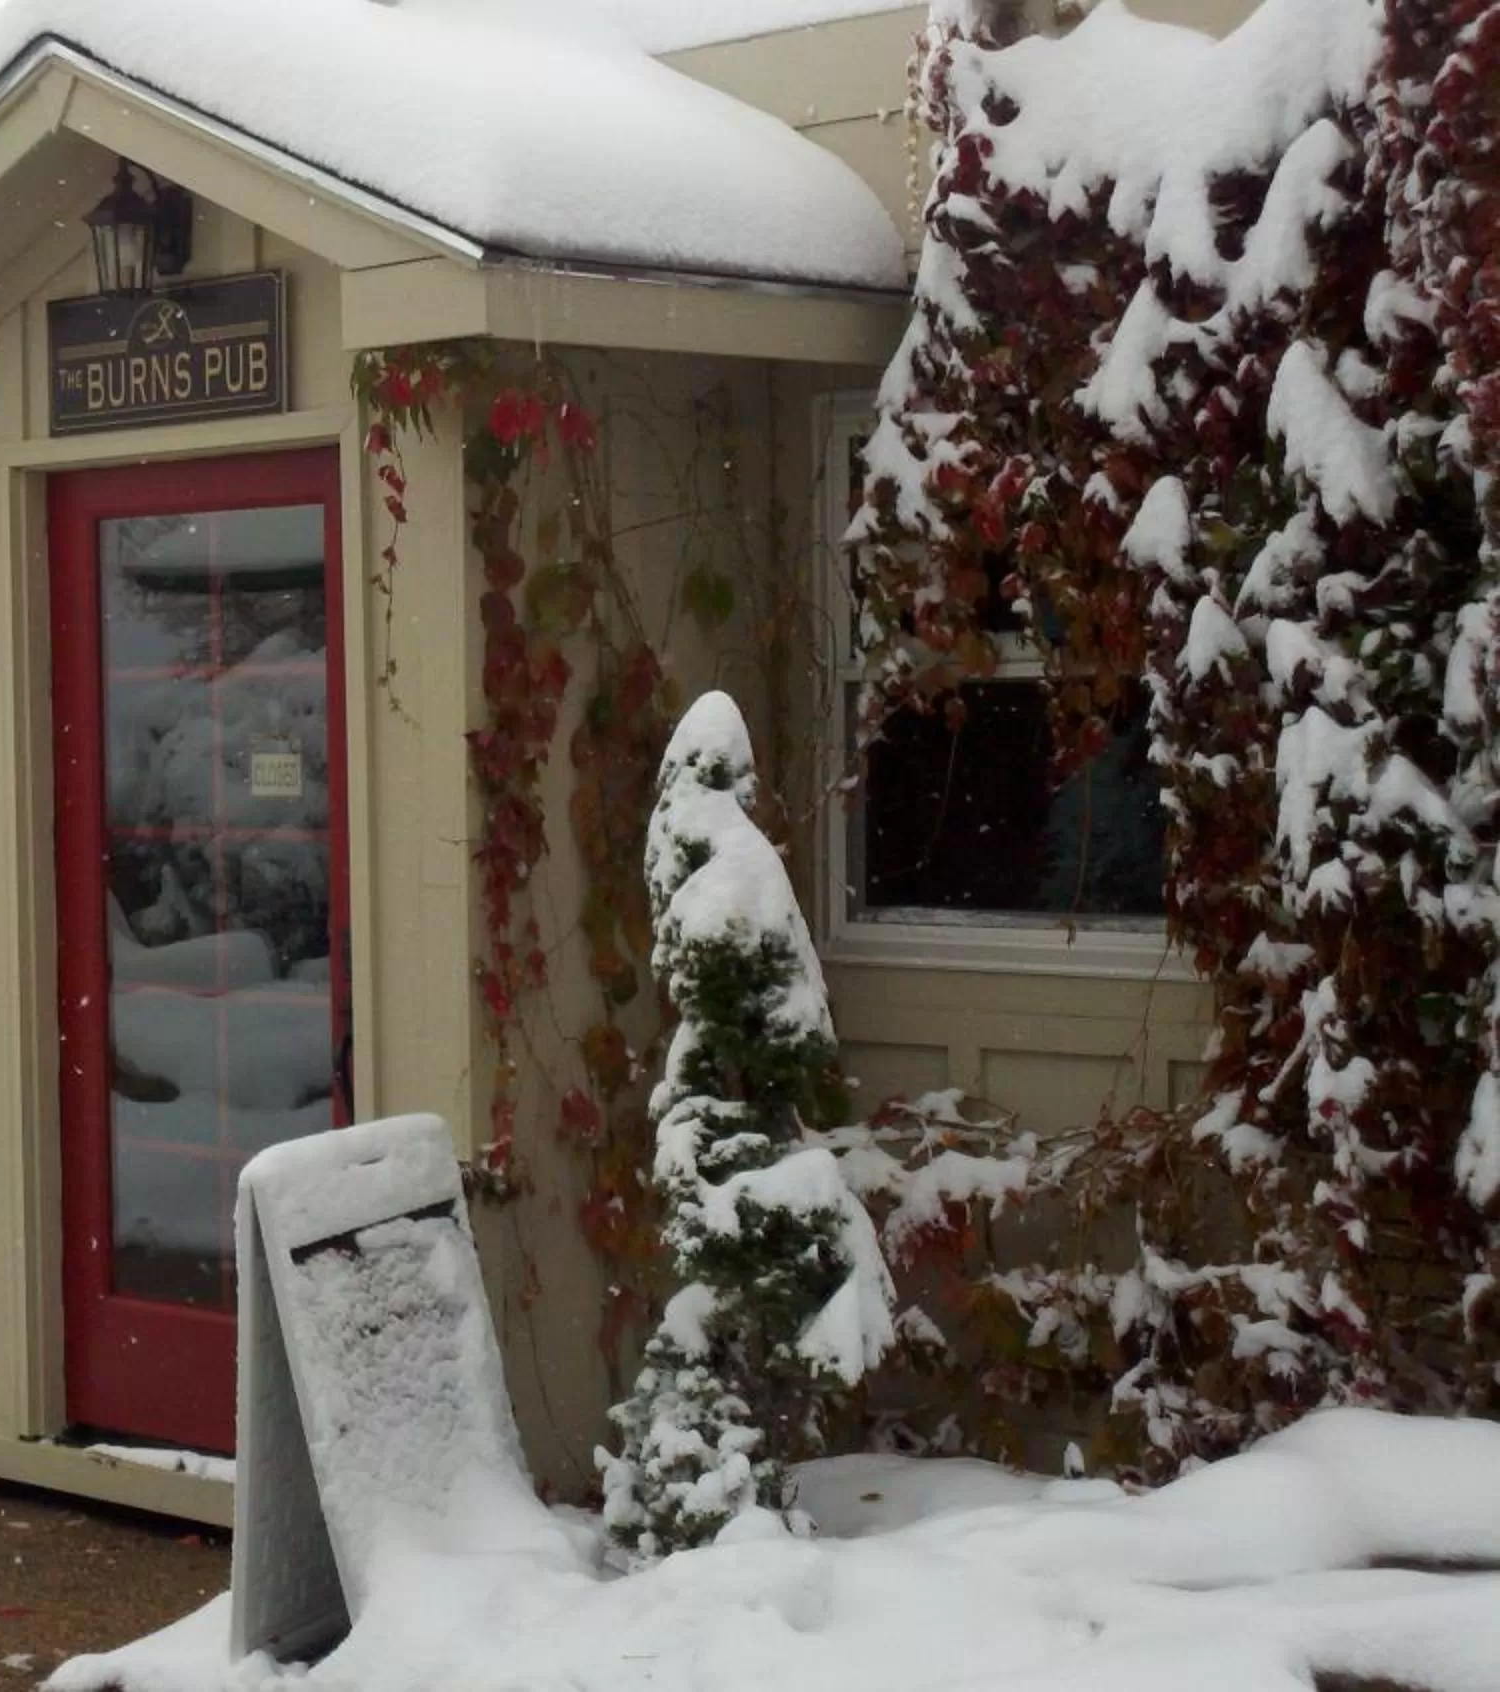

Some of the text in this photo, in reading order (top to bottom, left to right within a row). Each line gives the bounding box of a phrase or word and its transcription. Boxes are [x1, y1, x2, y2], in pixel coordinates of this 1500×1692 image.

[58, 341, 268, 409] THE BURNS PUB
